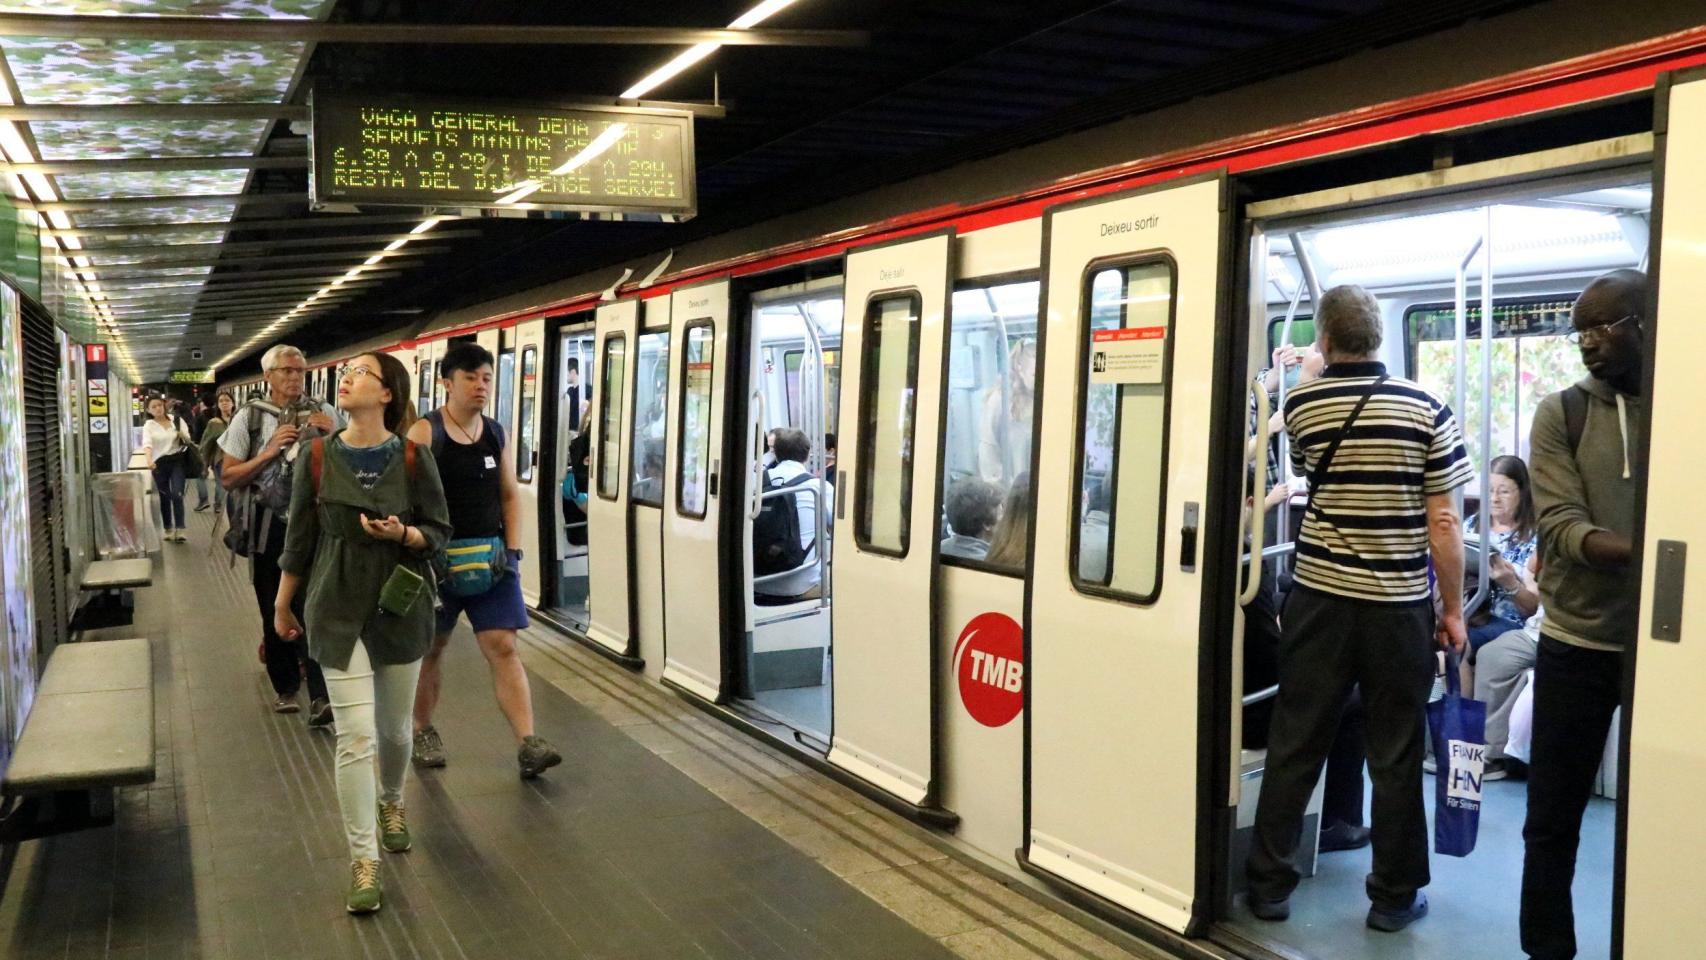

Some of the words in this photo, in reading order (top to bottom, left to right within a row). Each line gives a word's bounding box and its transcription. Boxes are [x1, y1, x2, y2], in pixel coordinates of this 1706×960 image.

[334, 168, 405, 187] RESTA
[419, 171, 460, 190] DEL
[604, 177, 675, 197] SERVEI
[1100, 221, 1132, 237] Deixeu
[1134, 214, 1160, 231] sortir
[970, 649, 1023, 693] TMB
